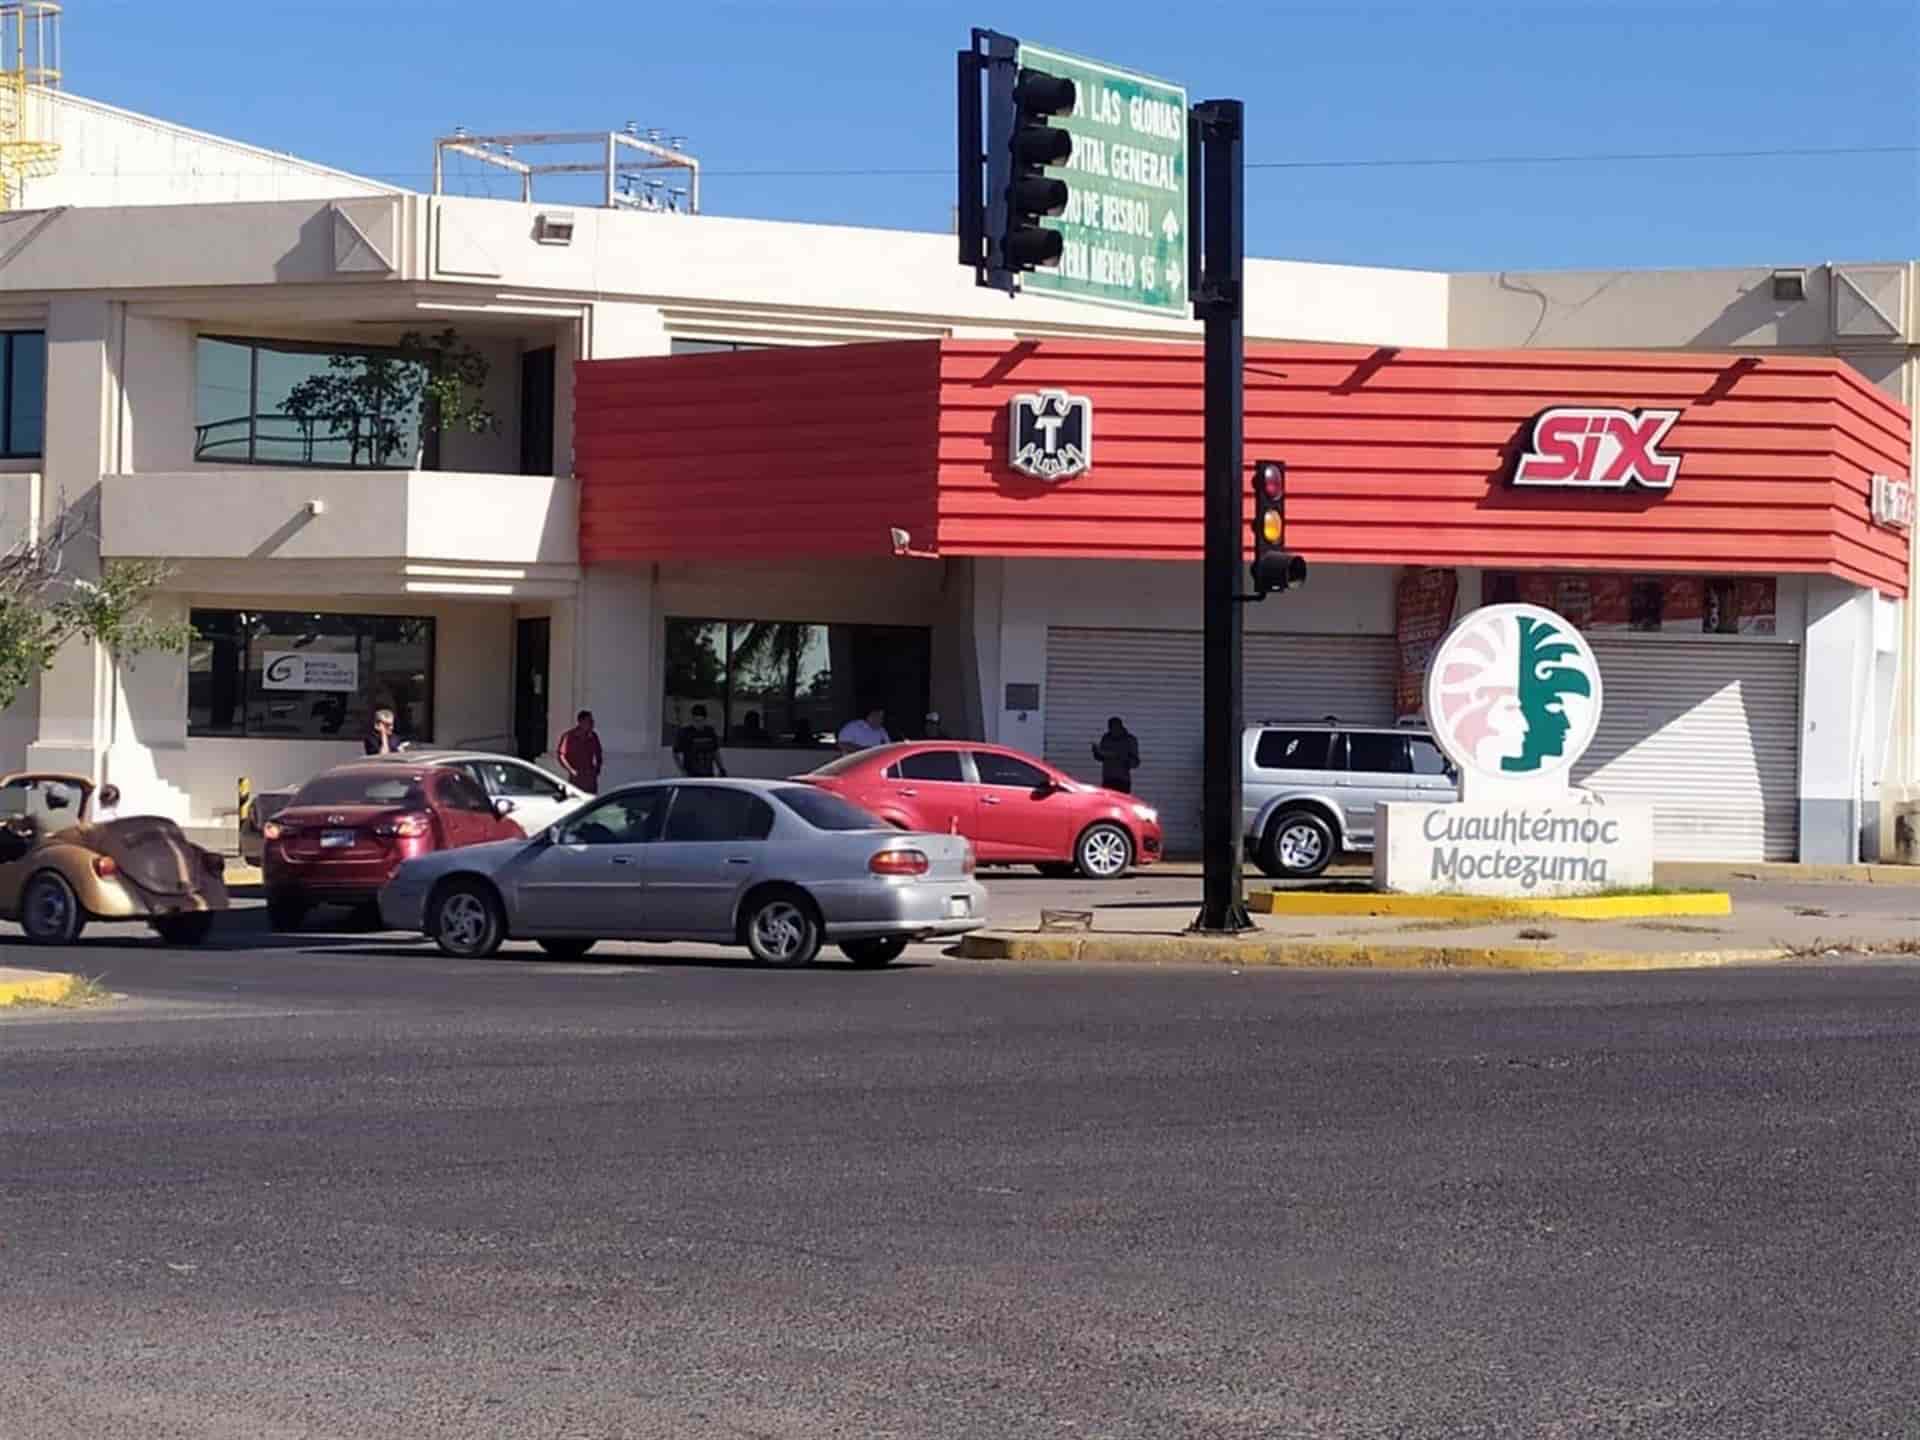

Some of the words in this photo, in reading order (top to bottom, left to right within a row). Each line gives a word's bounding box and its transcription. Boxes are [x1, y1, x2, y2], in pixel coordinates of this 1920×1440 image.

[1091, 83, 1121, 126] LAS
[1111, 143, 1179, 192] GENERAL
[1083, 189, 1099, 229] DE
[1423, 808, 1620, 846] Cuauhtémoc
[1431, 847, 1608, 889] Moctezuma
